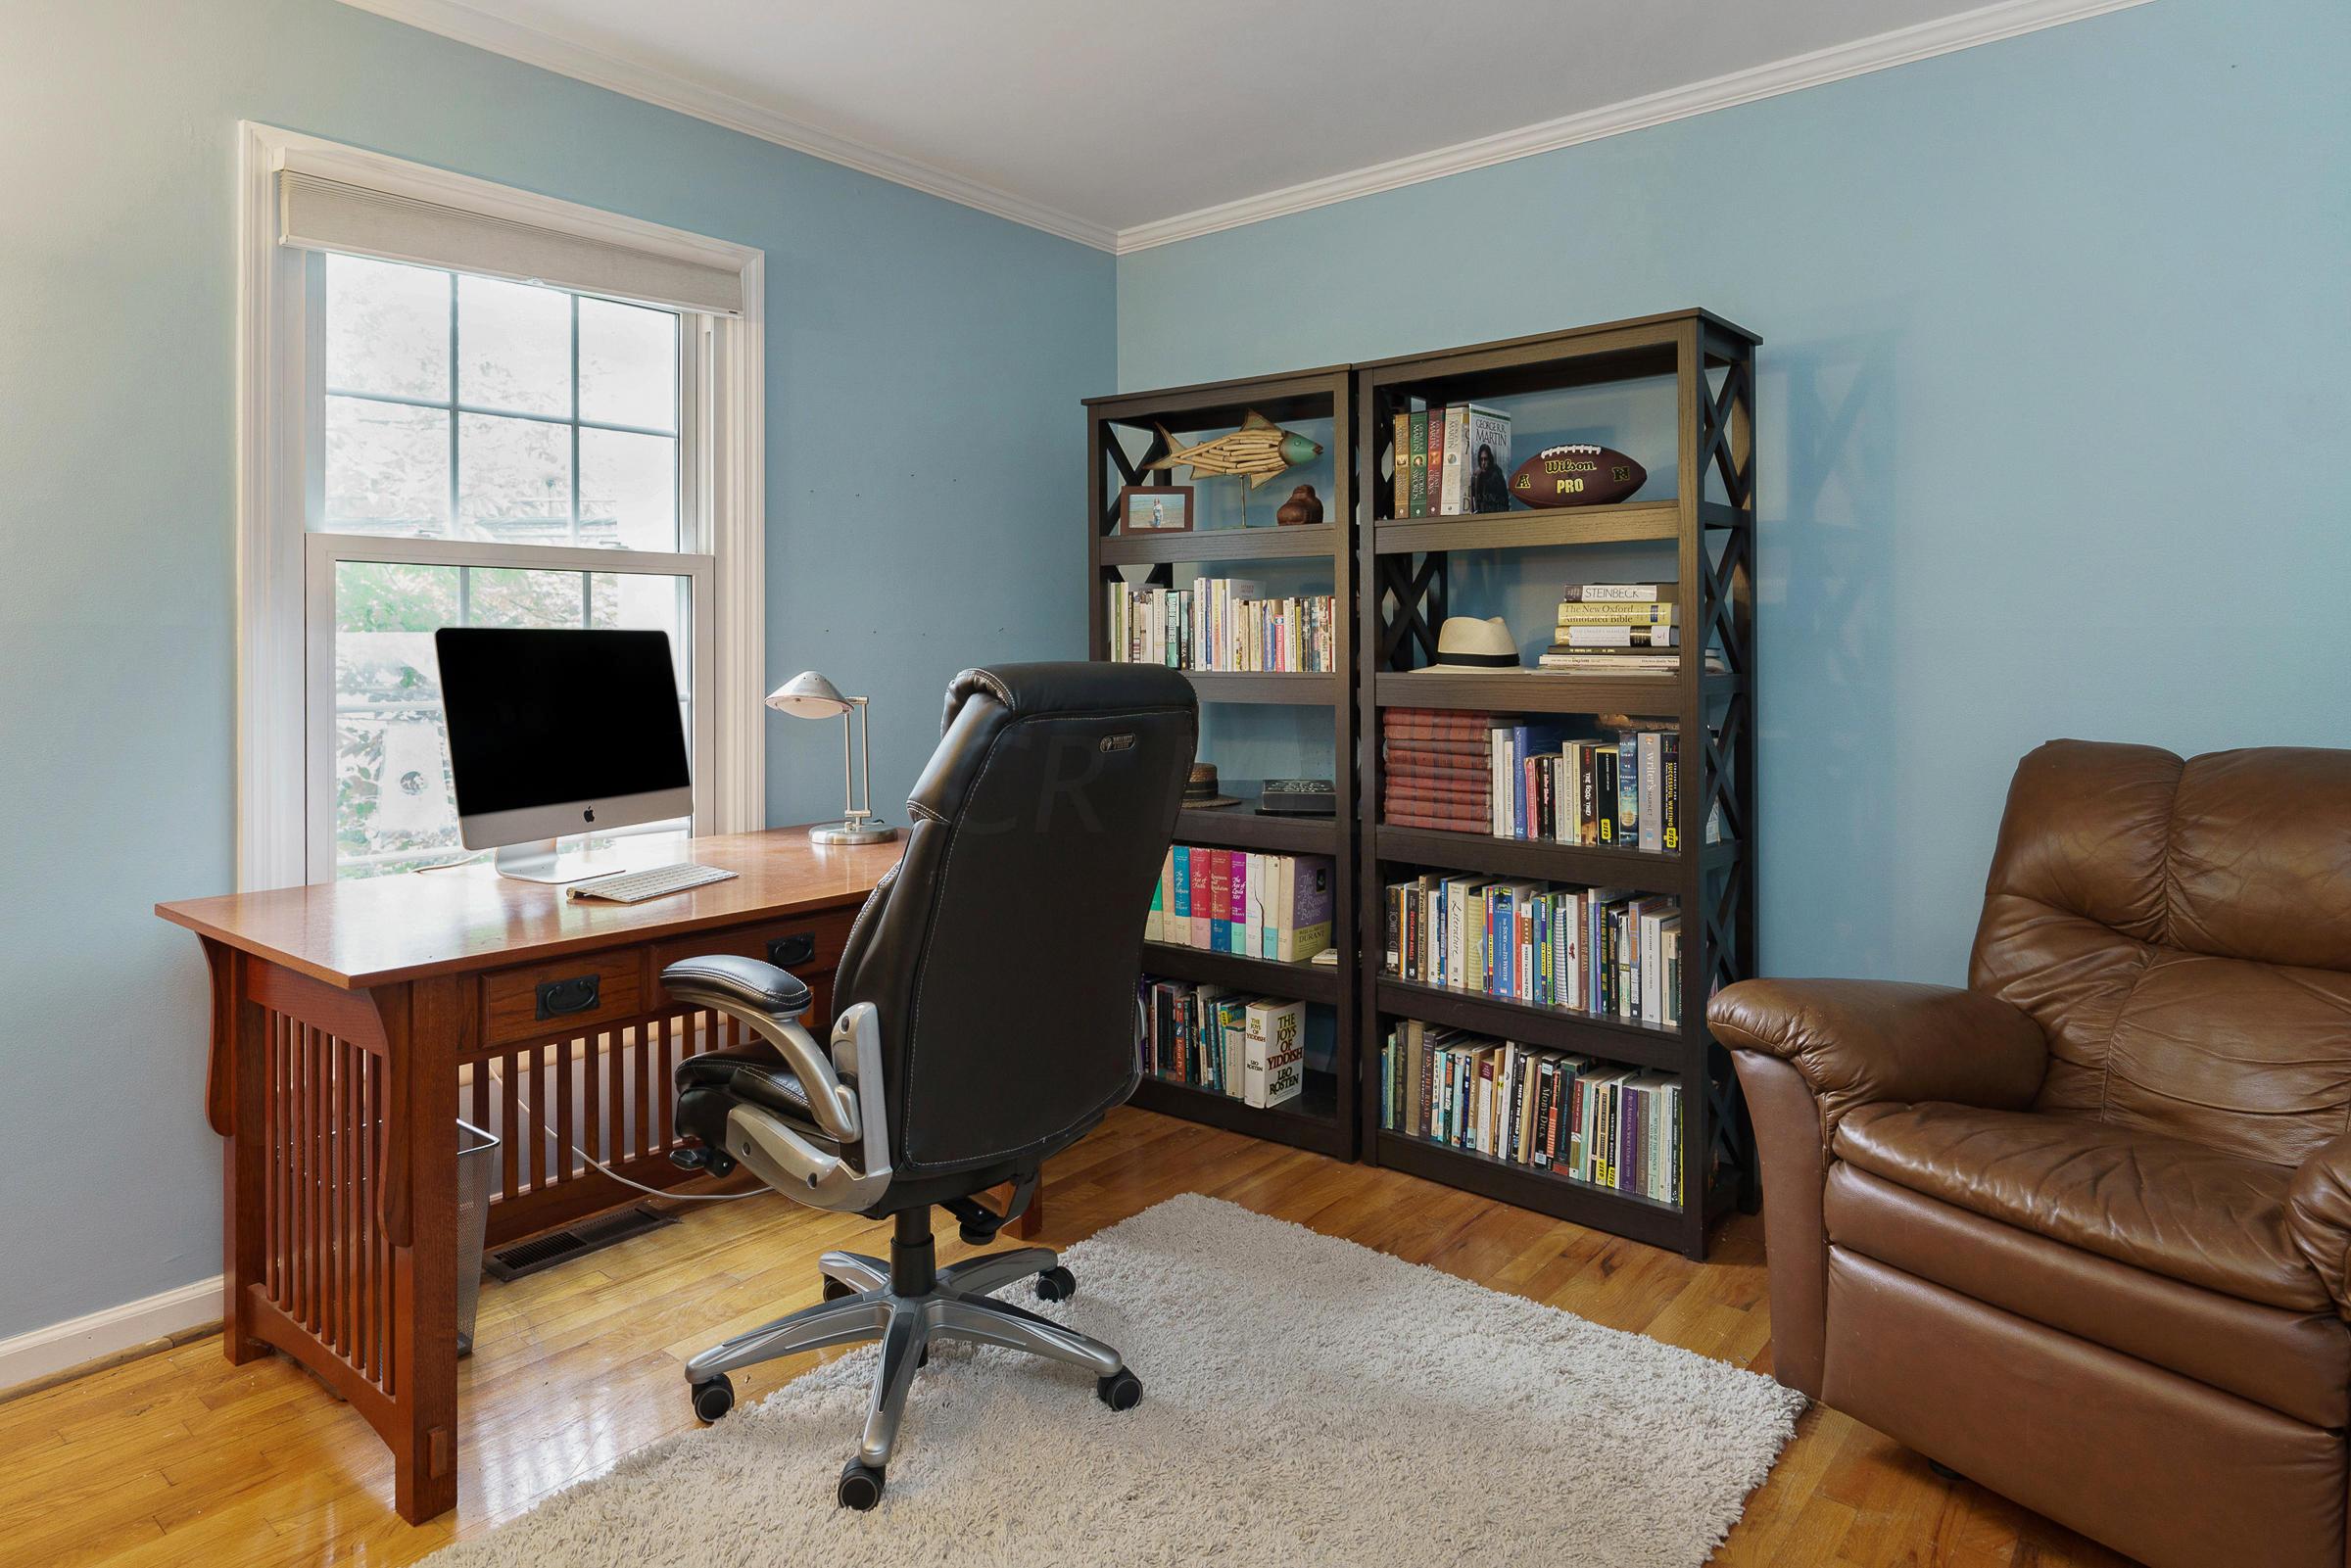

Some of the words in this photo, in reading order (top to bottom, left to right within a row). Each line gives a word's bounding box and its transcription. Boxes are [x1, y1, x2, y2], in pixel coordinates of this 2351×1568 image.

[1476, 419, 1495, 429] GEORGE
[1476, 430, 1507, 447] MARTIN
[1545, 459, 1597, 474] Wilson
[1557, 478, 1584, 494] PRO
[1585, 588, 1640, 598] STEINBECK
[1603, 604, 1634, 613] Oxford
[1647, 752, 1656, 791] writer's
[1302, 873, 1314, 884] The
[1420, 883, 1425, 893] Up
[1299, 931, 1324, 943] DURANT
[1452, 901, 1462, 962] Literature
[1277, 1013, 1296, 1027] THE
[1247, 1034, 1266, 1043] YIDDISH
[1276, 1024, 1297, 1046] JOYS
[1279, 1039, 1293, 1055] OF
[1267, 1048, 1304, 1070] YIDDISH
[1426, 1056, 1431, 1068] ON
[1247, 1064, 1263, 1072] ROSTEN
[1276, 1067, 1292, 1080] LEO
[1270, 1073, 1299, 1096] ROSTEN
[1538, 1086, 1551, 1138] MOBY-DICK
